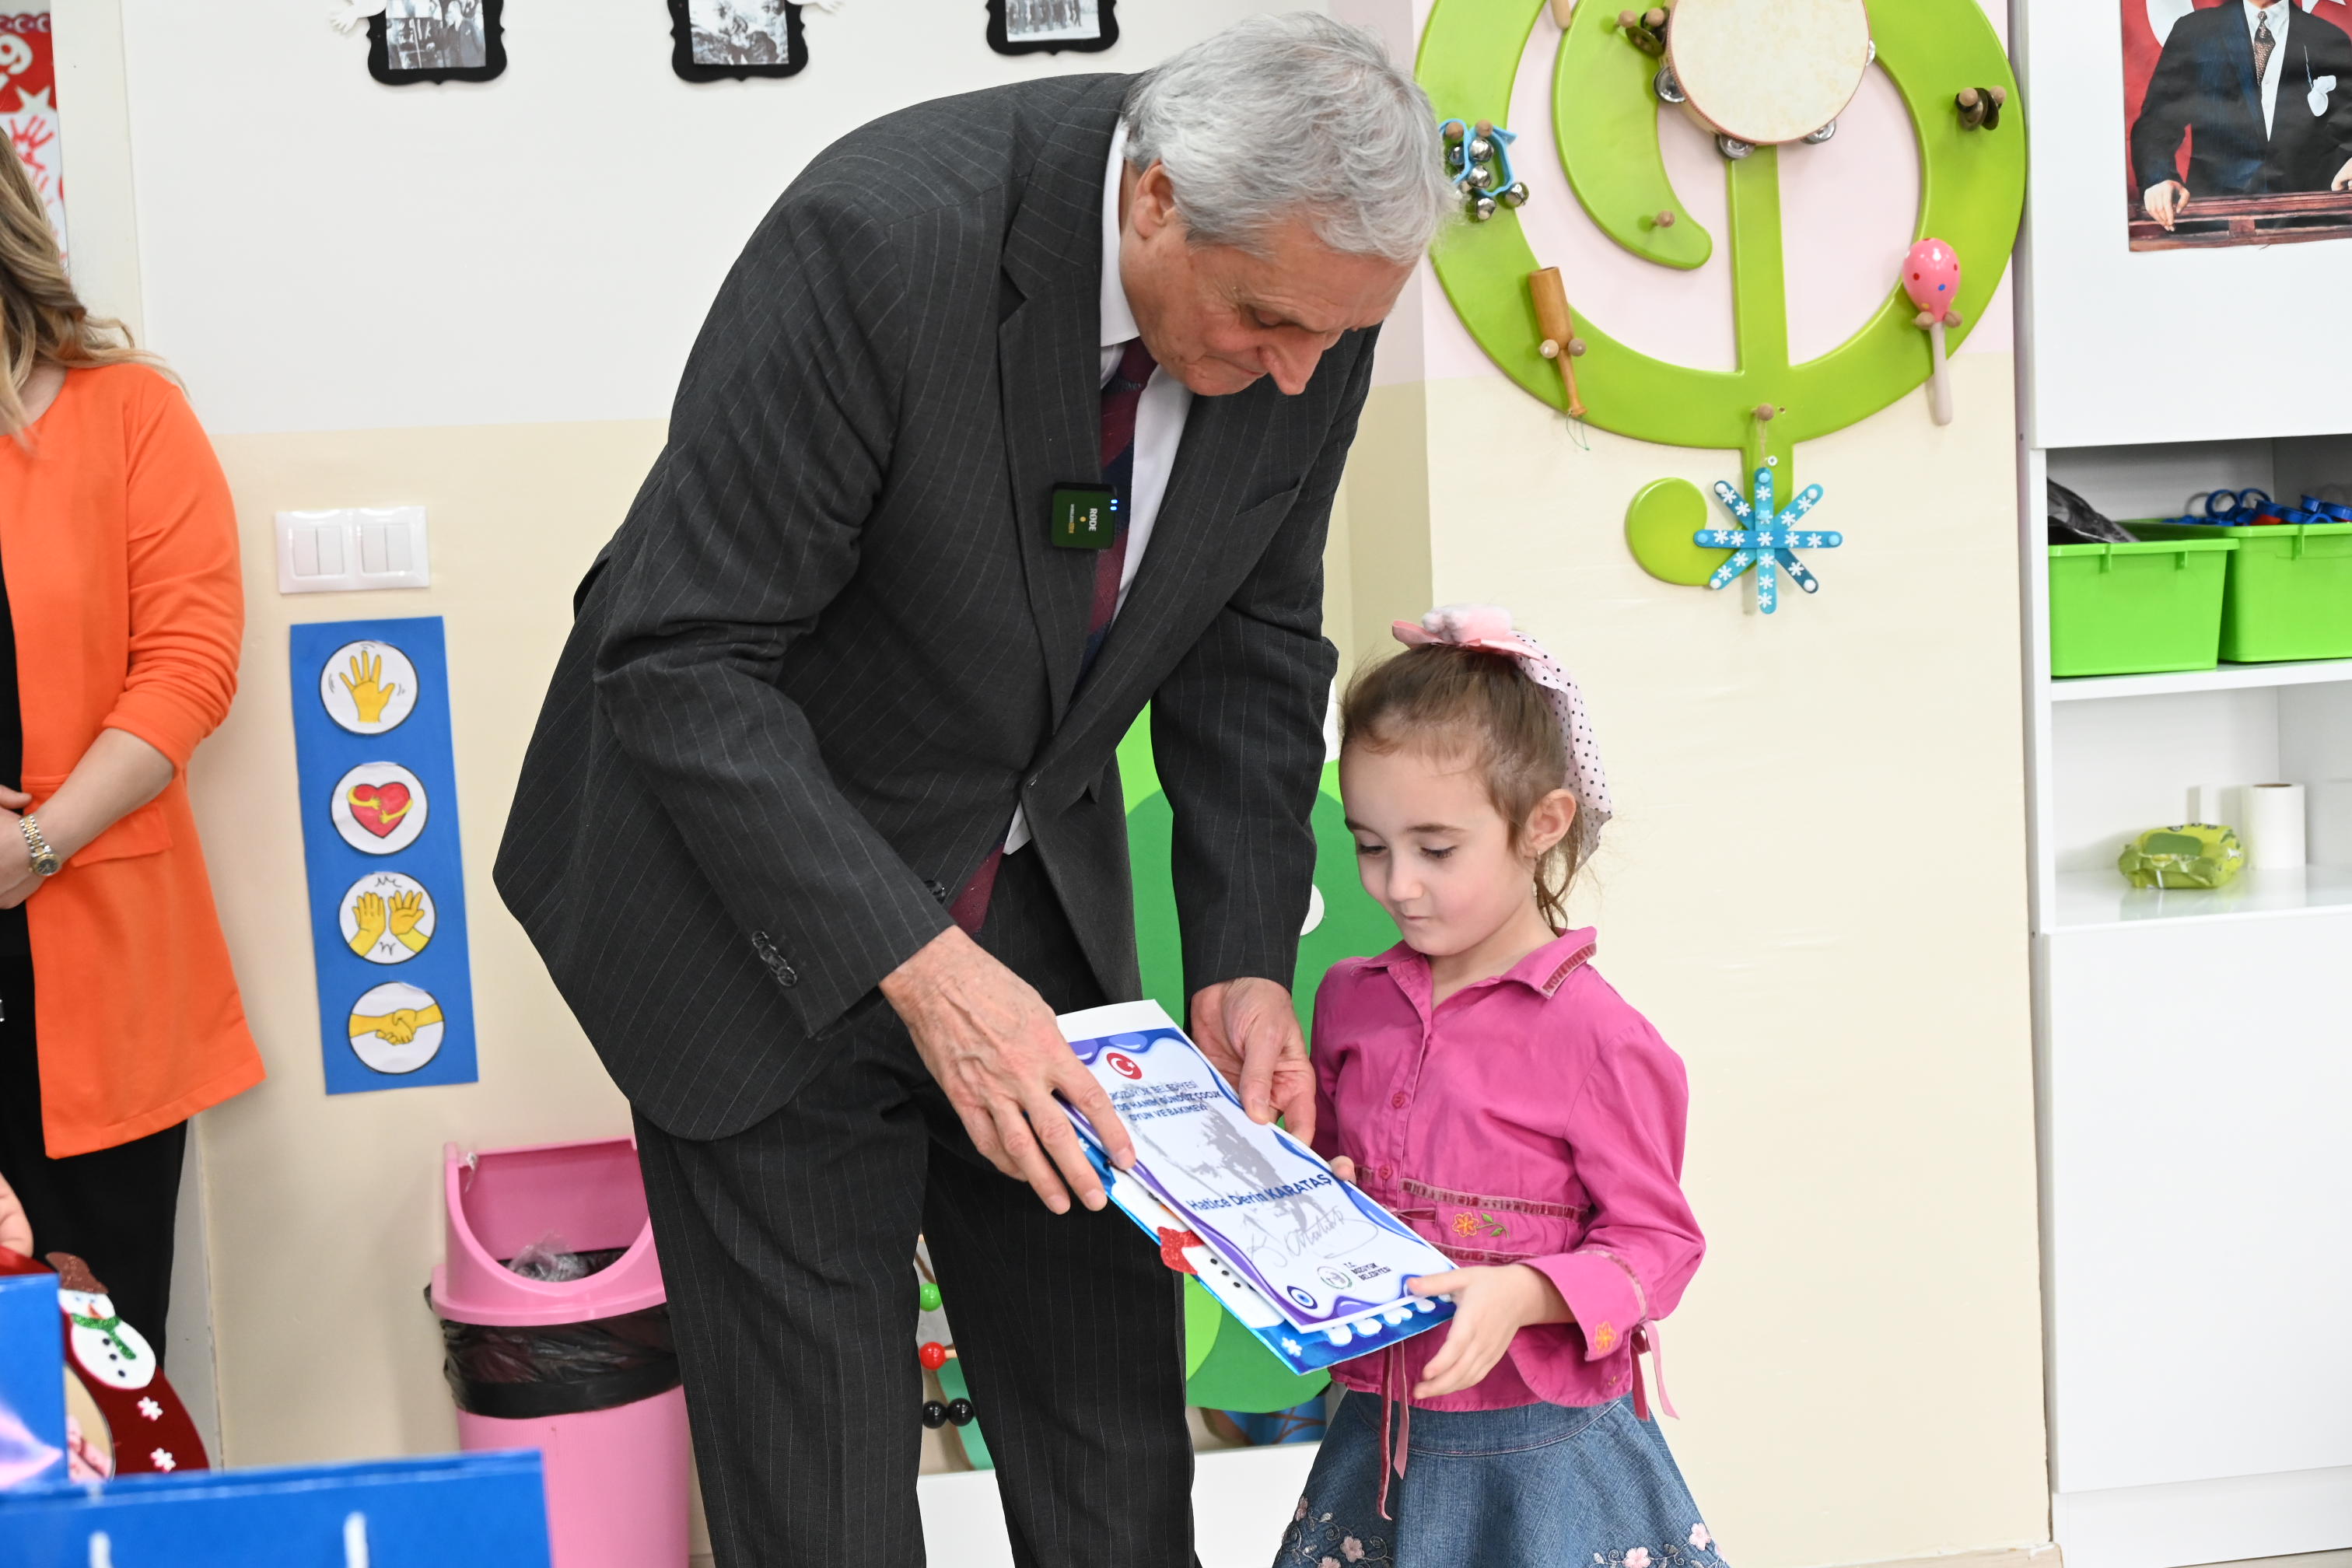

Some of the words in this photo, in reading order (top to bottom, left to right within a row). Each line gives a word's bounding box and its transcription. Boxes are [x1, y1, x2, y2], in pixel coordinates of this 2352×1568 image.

[1129, 1110, 1154, 1122] OYUN
[1153, 1108, 1167, 1118] VE
[1185, 1197, 1231, 1211] Hatice
[1228, 1192, 1268, 1206] Derin
[1264, 1174, 1332, 1200] KARATAŞ
